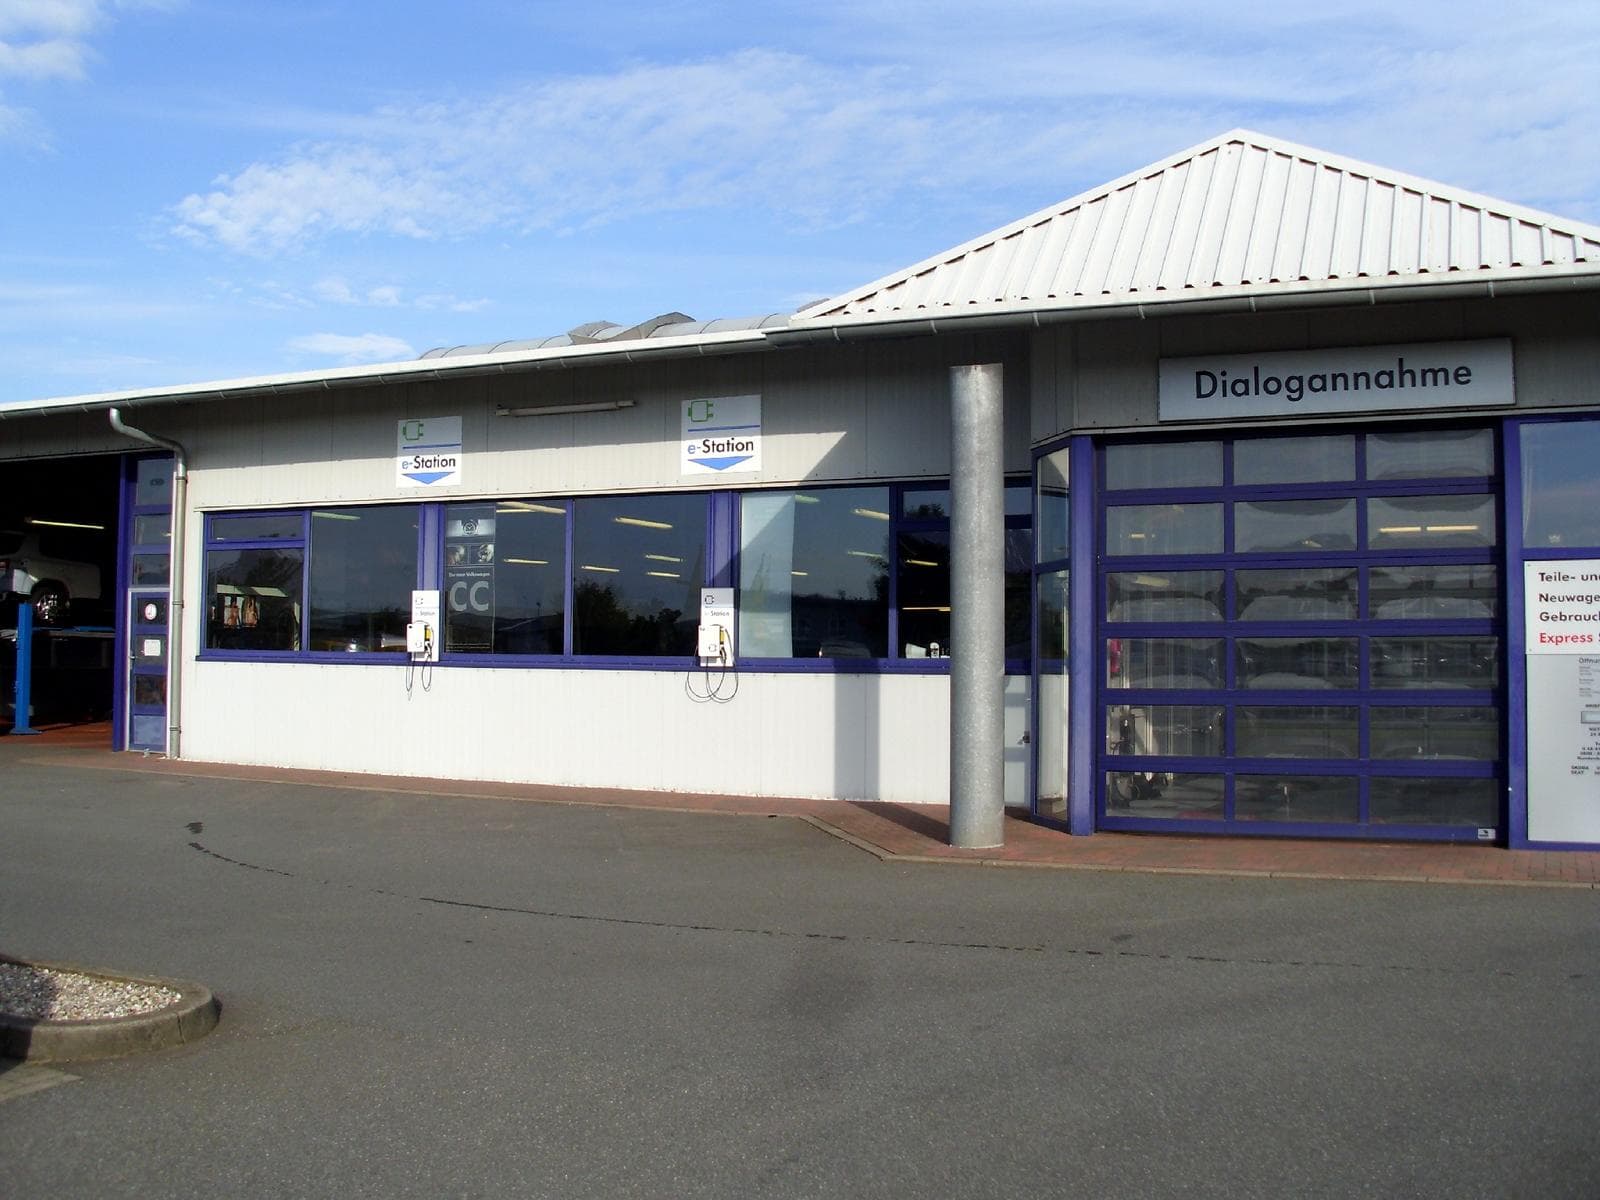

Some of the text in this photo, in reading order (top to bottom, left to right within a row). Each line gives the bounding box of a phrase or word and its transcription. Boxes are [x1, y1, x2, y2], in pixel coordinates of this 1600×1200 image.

[1195, 357, 1473, 402] Dialogannahme
[687, 437, 754, 454] e-Station
[401, 454, 456, 469] e-Station
[1538, 571, 1600, 582] Teile- un
[449, 580, 489, 612] CC
[1539, 611, 1600, 622] Gebrauc
[1539, 632, 1594, 646] Express
